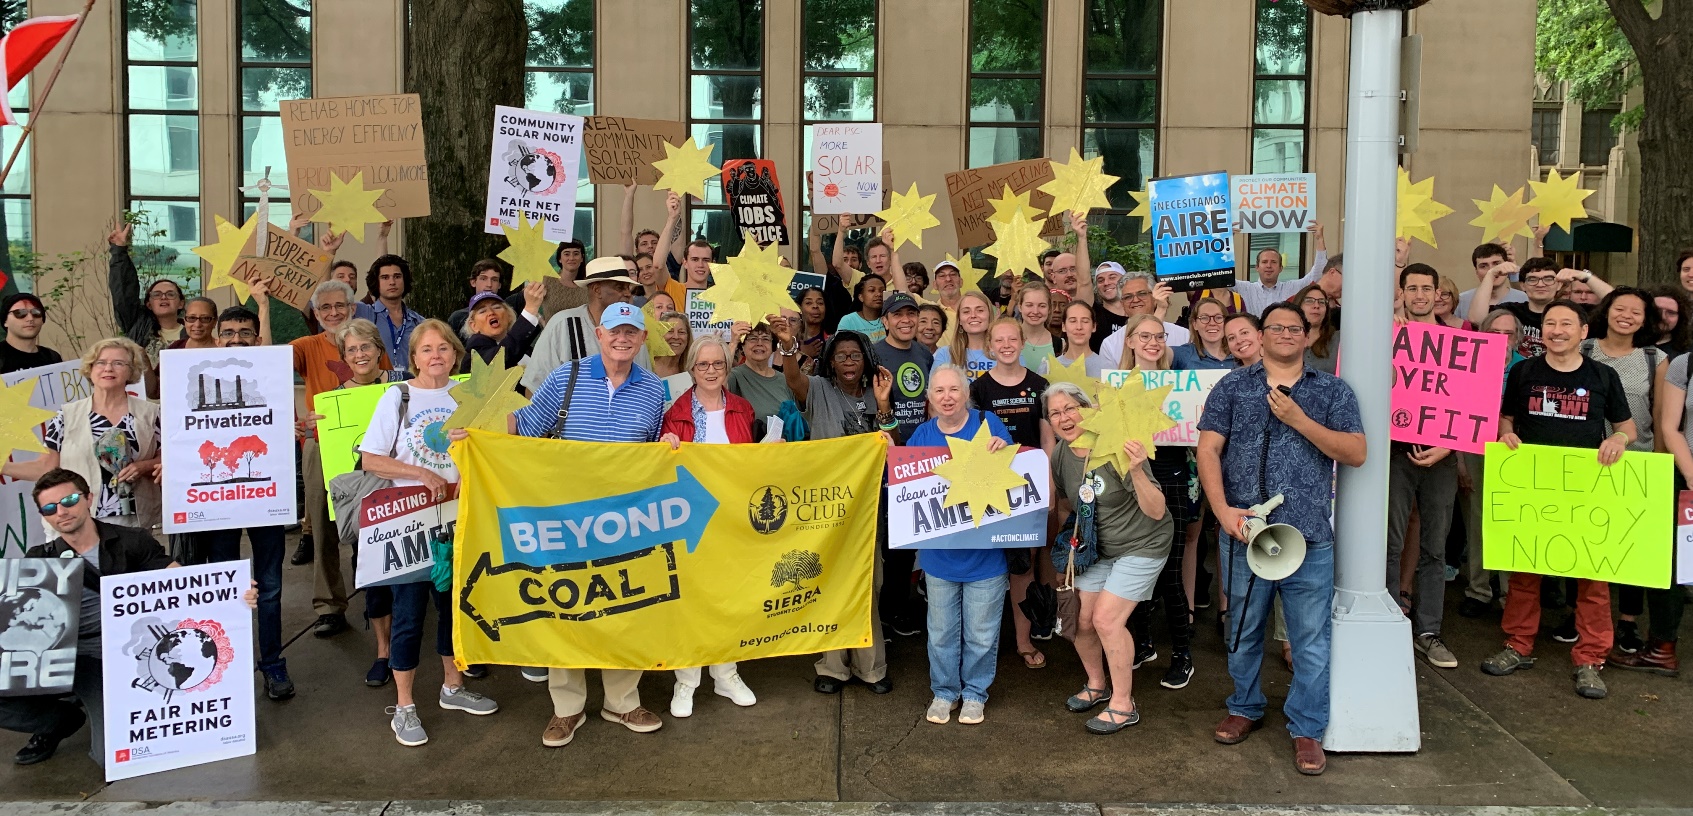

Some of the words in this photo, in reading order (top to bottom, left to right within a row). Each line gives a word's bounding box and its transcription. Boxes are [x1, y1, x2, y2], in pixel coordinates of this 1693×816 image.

[289, 100, 339, 121] REHAB
[345, 99, 387, 117] HOMES
[390, 97, 415, 114] FOR
[501, 115, 575, 132] COMMUNITY
[583, 116, 634, 131] REAL
[817, 127, 841, 136] DEAR
[293, 127, 345, 146] ENERGY
[353, 123, 418, 143] EFFICIENCY
[500, 127, 539, 139] SOLAR
[543, 132, 574, 144] NOW!
[584, 132, 673, 150] COMMUNITY
[819, 141, 848, 150] MORE
[590, 149, 646, 165] SOLAR
[818, 155, 876, 177] SOLAR
[592, 166, 637, 181] NOW!
[946, 170, 982, 194] FAIR
[857, 182, 878, 191] NOW
[961, 188, 985, 211] NET
[988, 162, 1049, 199] METERING
[1239, 182, 1307, 195] CLIMATE
[501, 197, 530, 208] FAIR
[536, 201, 560, 211] NET
[740, 194, 768, 204] CLIMATE
[1154, 195, 1227, 211] ¡NECESITAMOS
[1238, 196, 1307, 209] ACTION
[738, 205, 776, 225] JOBS
[1157, 210, 1228, 239] AIRE
[1240, 209, 1308, 229] NOW
[266, 232, 315, 267] PEOPLE'S
[1158, 237, 1230, 258] LIMPIO!
[274, 265, 316, 290] GREEN
[268, 275, 298, 305] DEAL
[690, 321, 734, 329] ENVIRON
[1393, 326, 1488, 373] ANET
[61, 369, 91, 402] BR
[1547, 393, 1589, 402] DEMOCRACY
[185, 409, 272, 430] Privatized
[434, 407, 455, 415] GEO
[1168, 400, 1183, 420] &
[1499, 453, 1647, 498] CLEAN
[187, 482, 276, 503] Socialized
[791, 485, 854, 504] SIERRA
[897, 486, 928, 503] clean
[930, 482, 950, 495] air
[366, 492, 427, 522] CREATING
[797, 503, 846, 522] CLUB
[912, 472, 1041, 536] AMECA
[188, 511, 204, 519] DSA
[509, 497, 690, 553] BEYOND
[1491, 491, 1646, 545] Energy
[367, 527, 401, 544] clean
[404, 519, 424, 534] air
[795, 523, 829, 531] FOUNDED
[991, 533, 1039, 543] #ACTONCLIMATE
[1512, 534, 1634, 575] NOW
[0, 558, 83, 595] PY
[112, 570, 236, 599] COMMUNITY
[519, 568, 645, 609] COAL
[763, 586, 821, 612] SIERRA
[113, 596, 179, 617] SOLAR
[187, 587, 238, 606] NOW!
[767, 609, 791, 618] STUDENT
[791, 598, 817, 612] COALITION
[740, 623, 838, 647] beyondcoal.org
[130, 705, 180, 724] FAIR
[191, 697, 231, 715] NET
[129, 715, 232, 743] METERING
[131, 746, 150, 756] DSA
